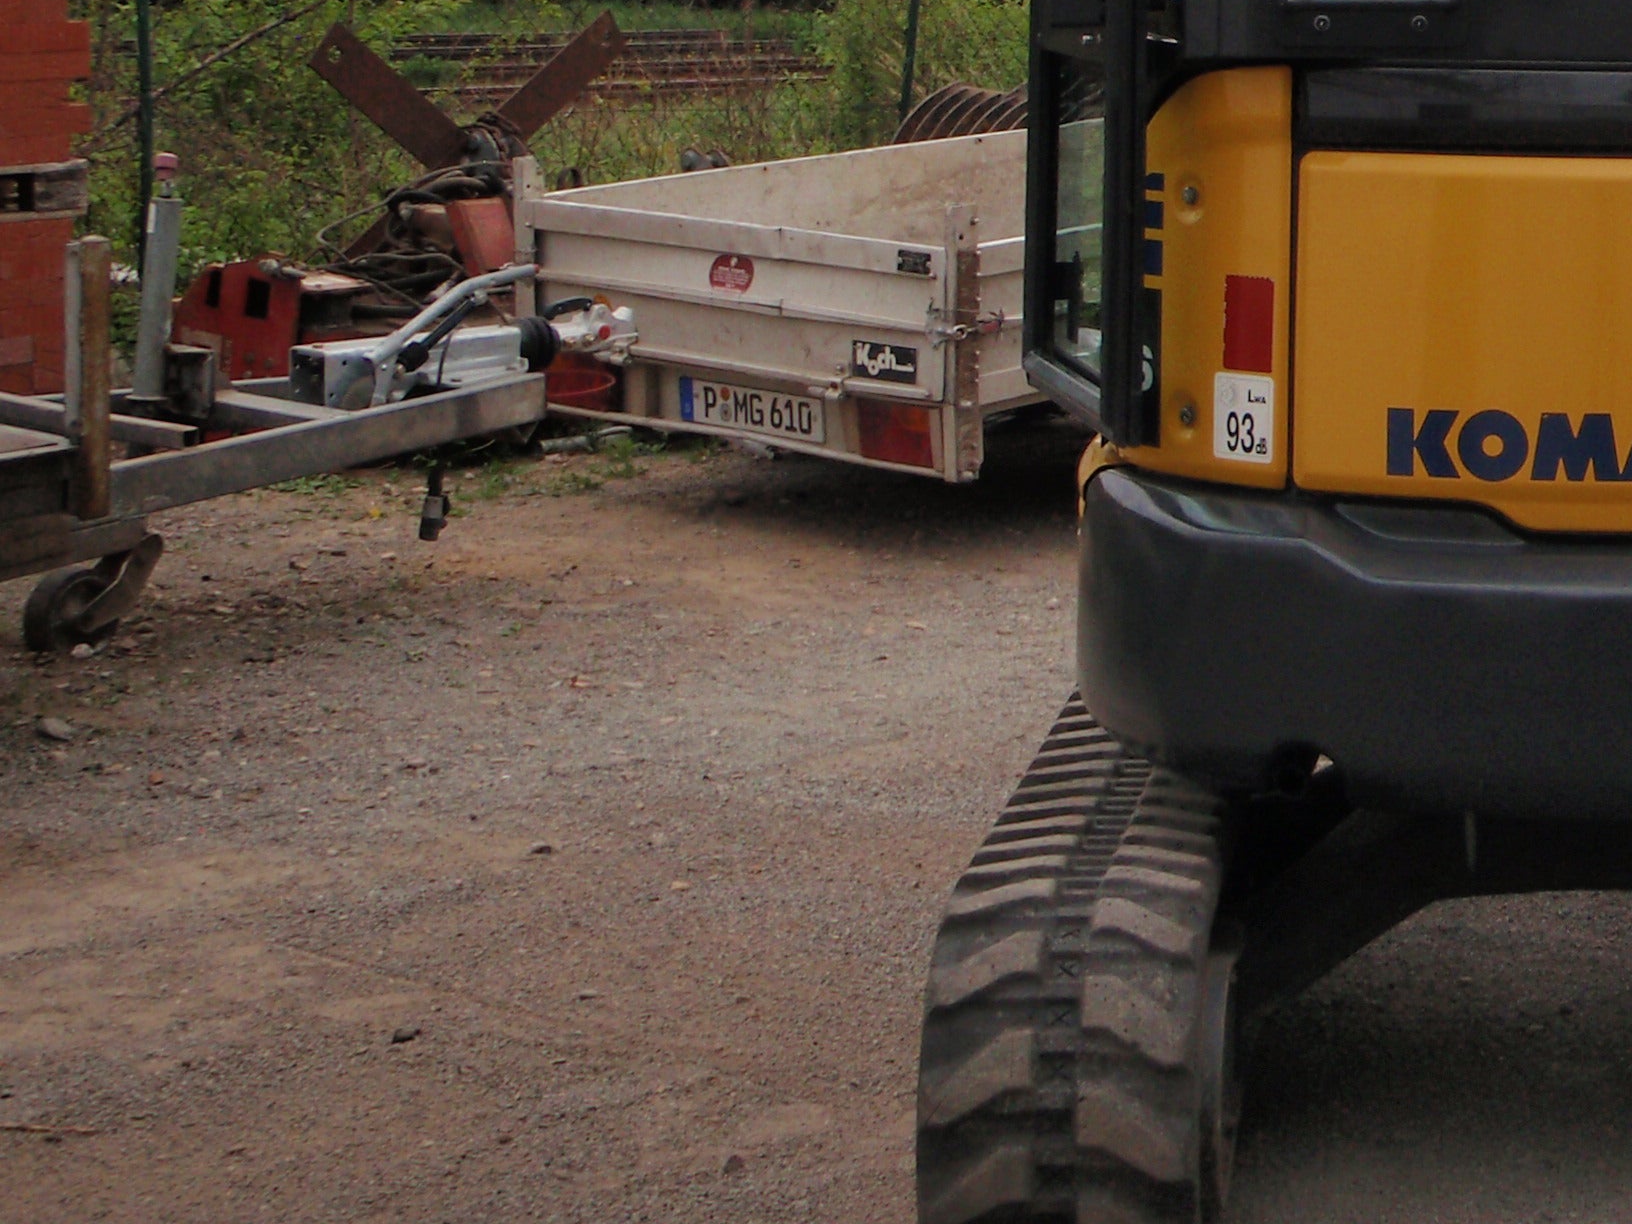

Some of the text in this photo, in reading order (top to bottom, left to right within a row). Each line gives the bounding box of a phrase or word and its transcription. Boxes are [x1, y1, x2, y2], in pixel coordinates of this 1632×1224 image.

[855, 342, 898, 376] Koch
[703, 386, 812, 435] P MG 610
